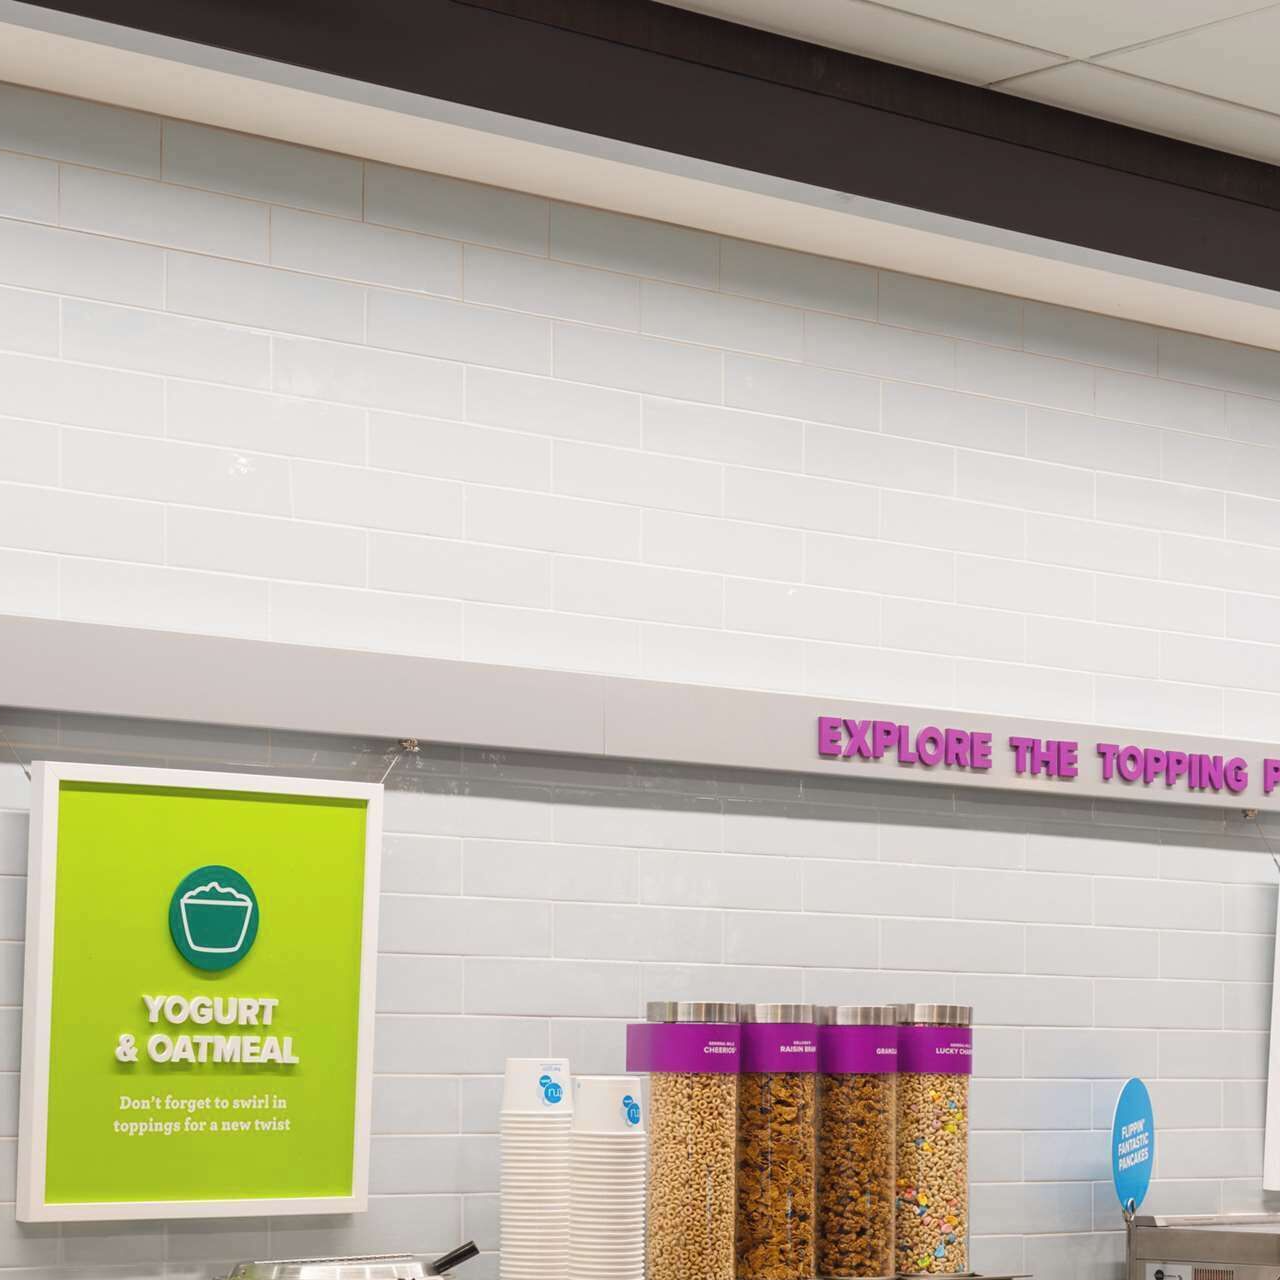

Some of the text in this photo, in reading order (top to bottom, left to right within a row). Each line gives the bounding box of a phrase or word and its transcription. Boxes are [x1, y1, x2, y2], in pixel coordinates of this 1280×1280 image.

[818, 715, 992, 770] EXPLORE
[1010, 735, 1078, 777] THE
[1097, 742, 1248, 793] TOPPING
[143, 994, 279, 1025] YOGURT
[115, 1033, 300, 1064] & OATMEAL
[120, 1095, 287, 1113] Don't forget to swirl in
[113, 1117, 291, 1136] toppings for a new twist
[1118, 1132, 1149, 1156] FANTASTIC
[1119, 1147, 1149, 1171] PANCAKES
